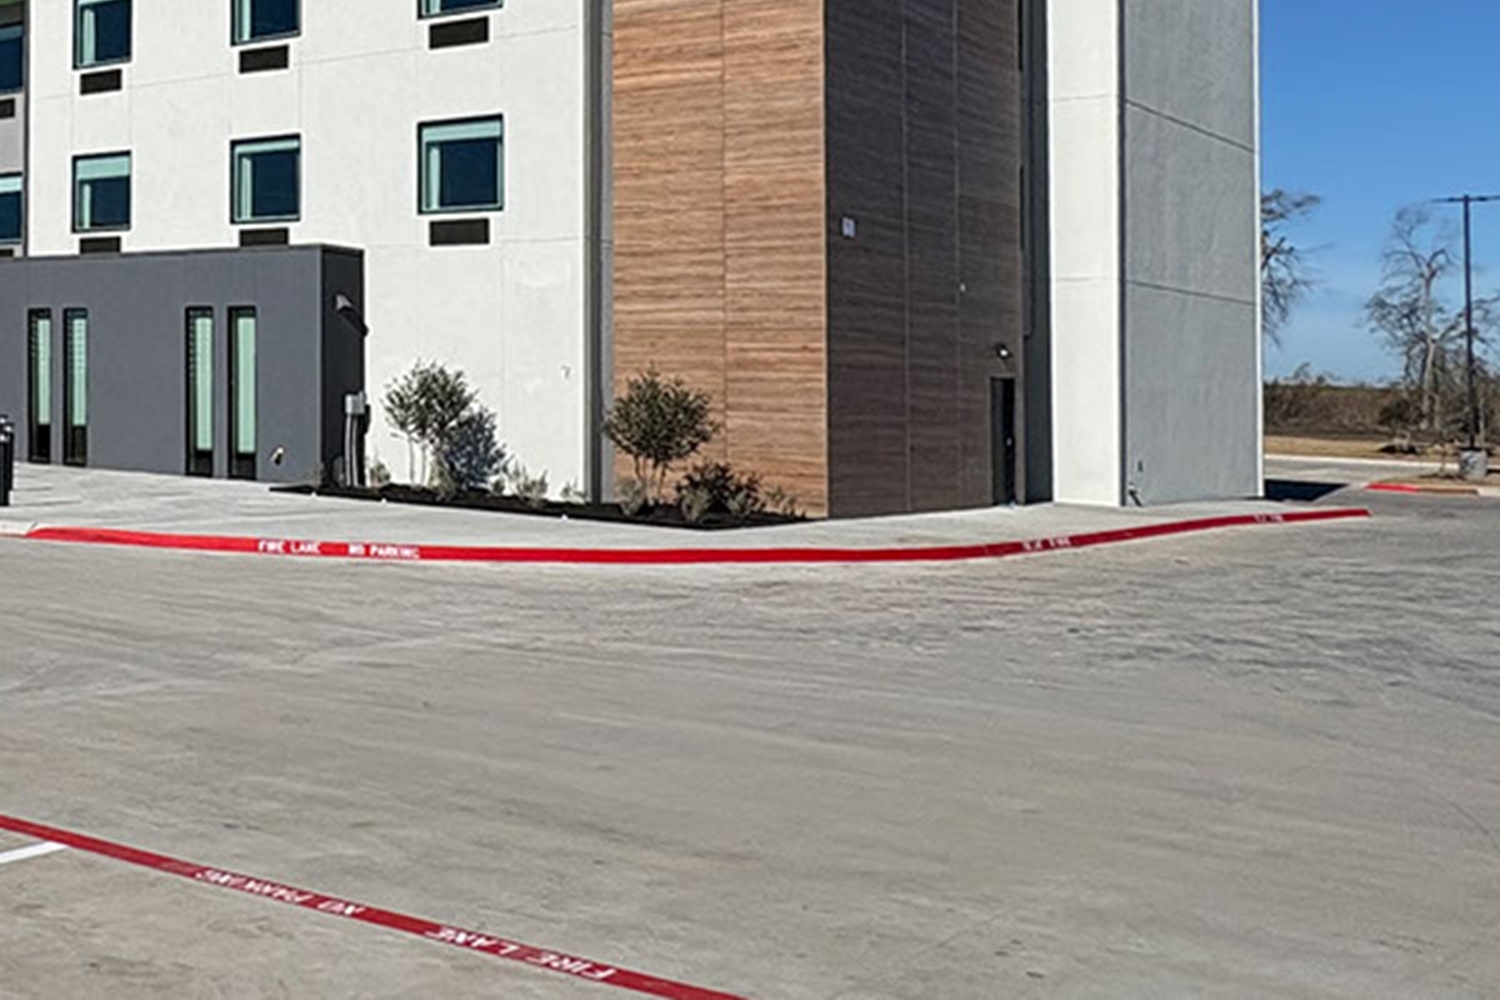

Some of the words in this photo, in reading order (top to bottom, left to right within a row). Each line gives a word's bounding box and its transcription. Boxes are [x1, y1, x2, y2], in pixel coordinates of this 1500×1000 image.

[258, 540, 284, 553] FIRE
[290, 541, 320, 554] LANE
[348, 543, 365, 556] NO
[369, 544, 420, 558] PARKING
[424, 925, 522, 956] LANE
[526, 951, 617, 980] FIRE
